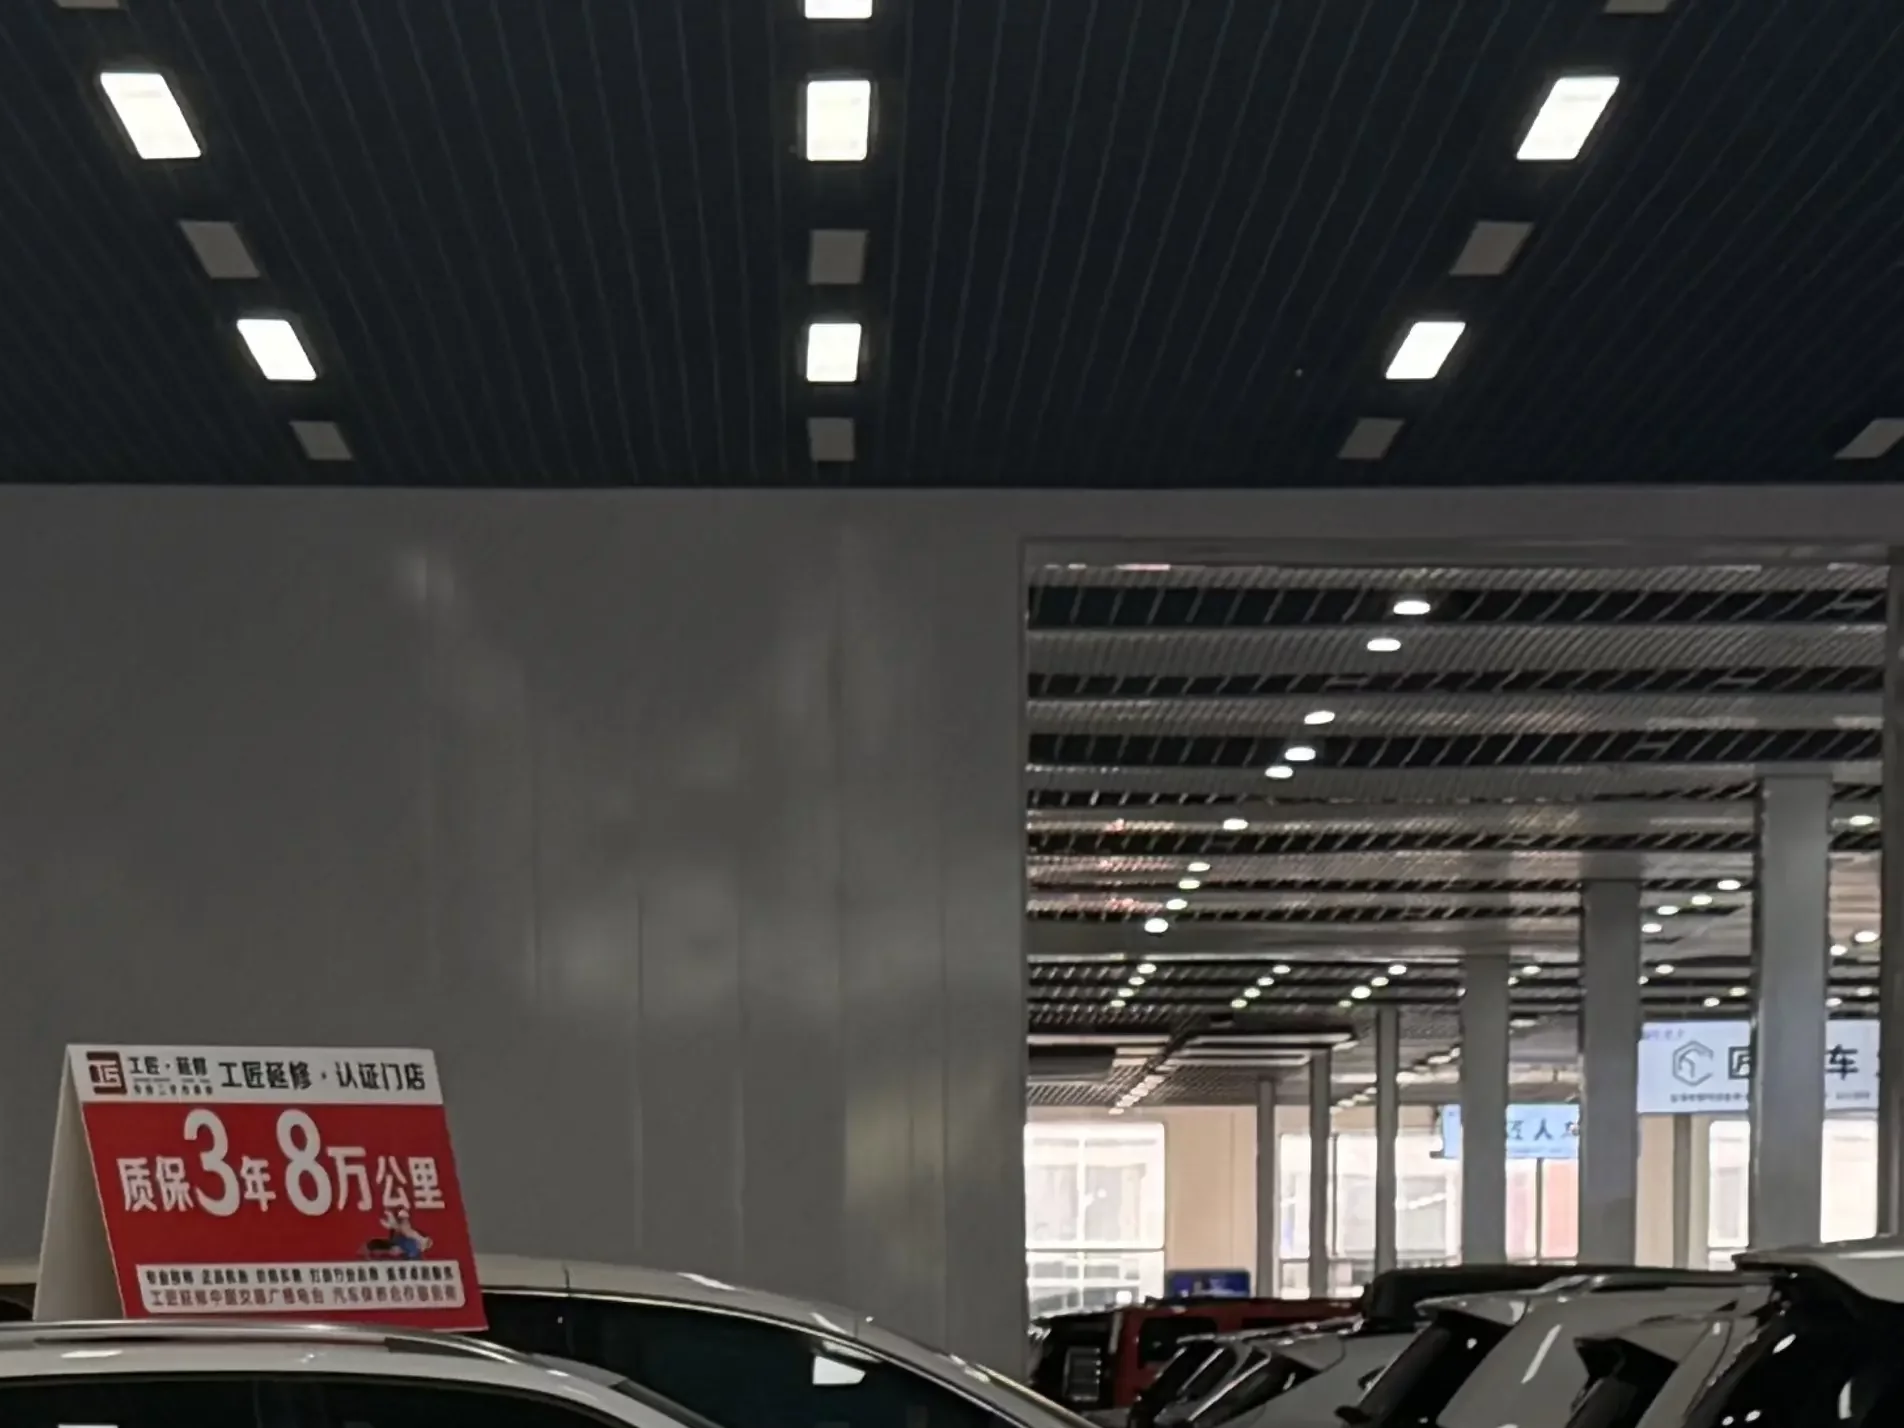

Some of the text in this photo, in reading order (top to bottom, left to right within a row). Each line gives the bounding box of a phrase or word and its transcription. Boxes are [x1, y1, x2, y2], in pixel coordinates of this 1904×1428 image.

[115, 1108, 446, 1217] 质保3年8万公里
